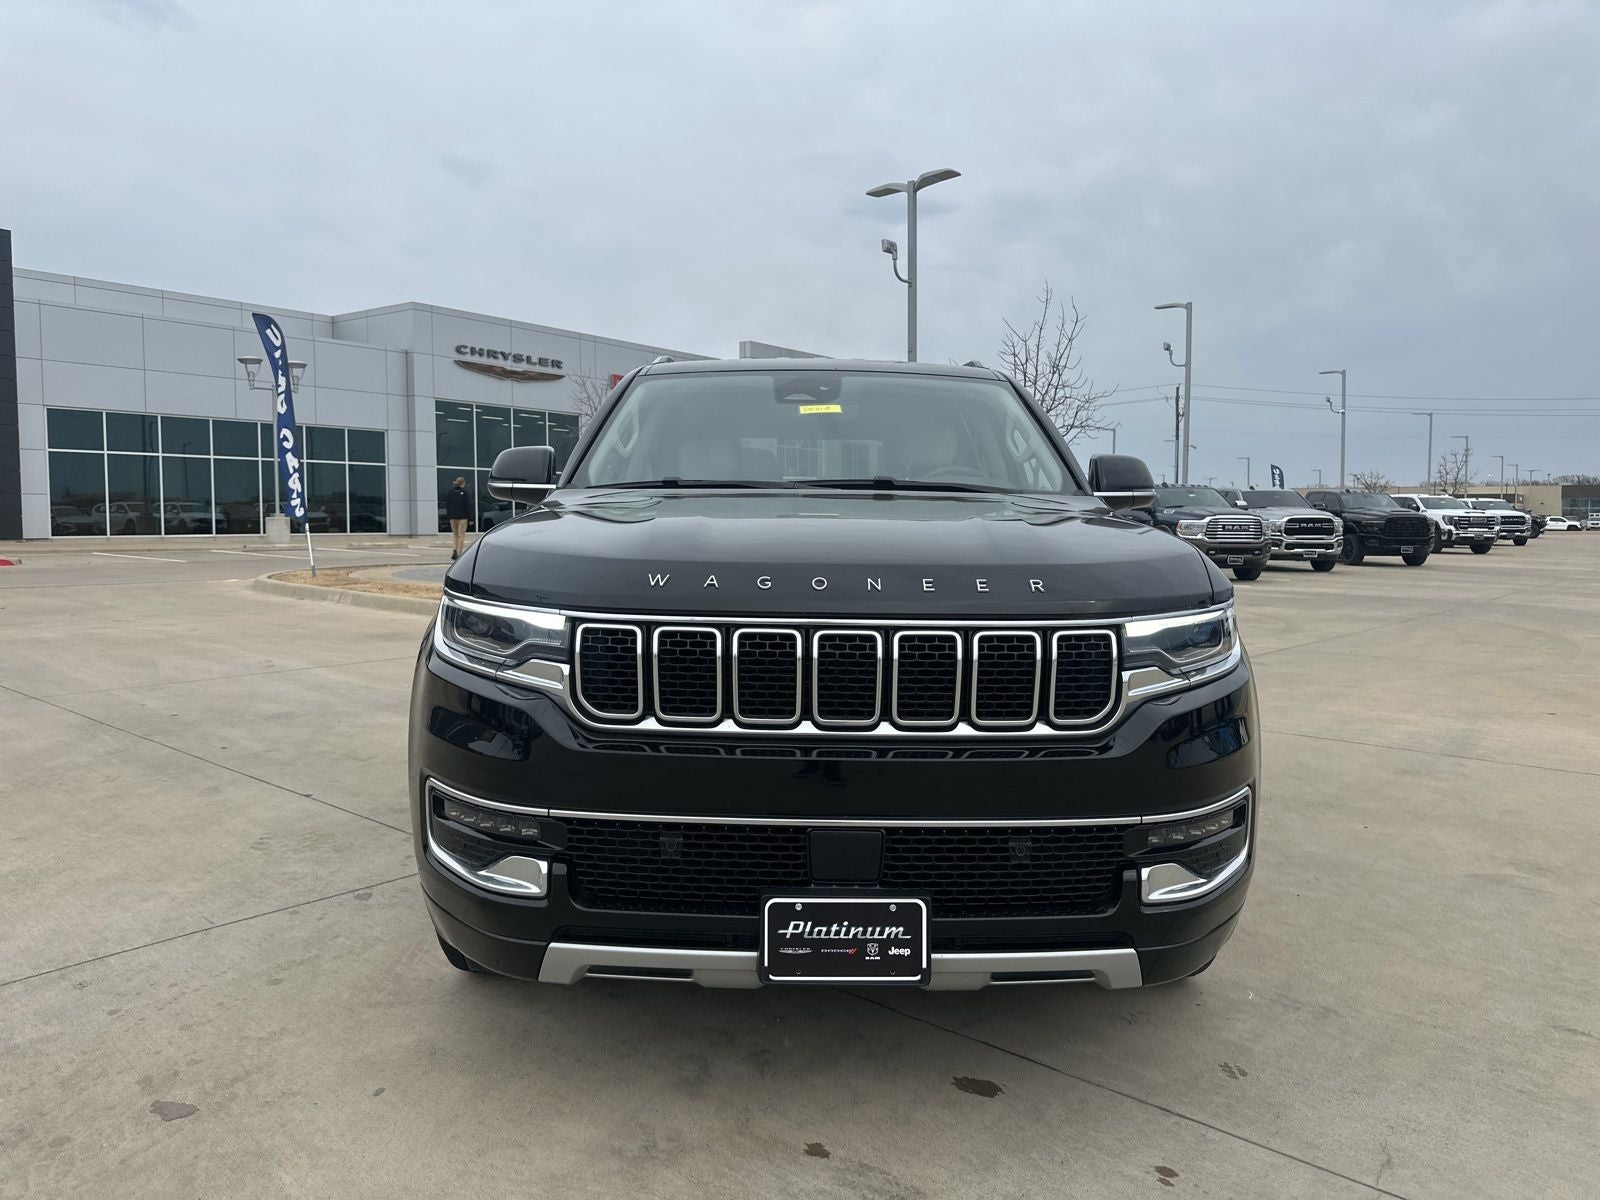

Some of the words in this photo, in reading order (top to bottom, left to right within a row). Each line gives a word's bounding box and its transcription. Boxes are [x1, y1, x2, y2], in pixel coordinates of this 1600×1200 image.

[455, 344, 563, 369] CHRYSLER
[647, 572, 1046, 593] WAGONEER
[777, 920, 912, 939] Platinum
[888, 946, 911, 956] Jeep
